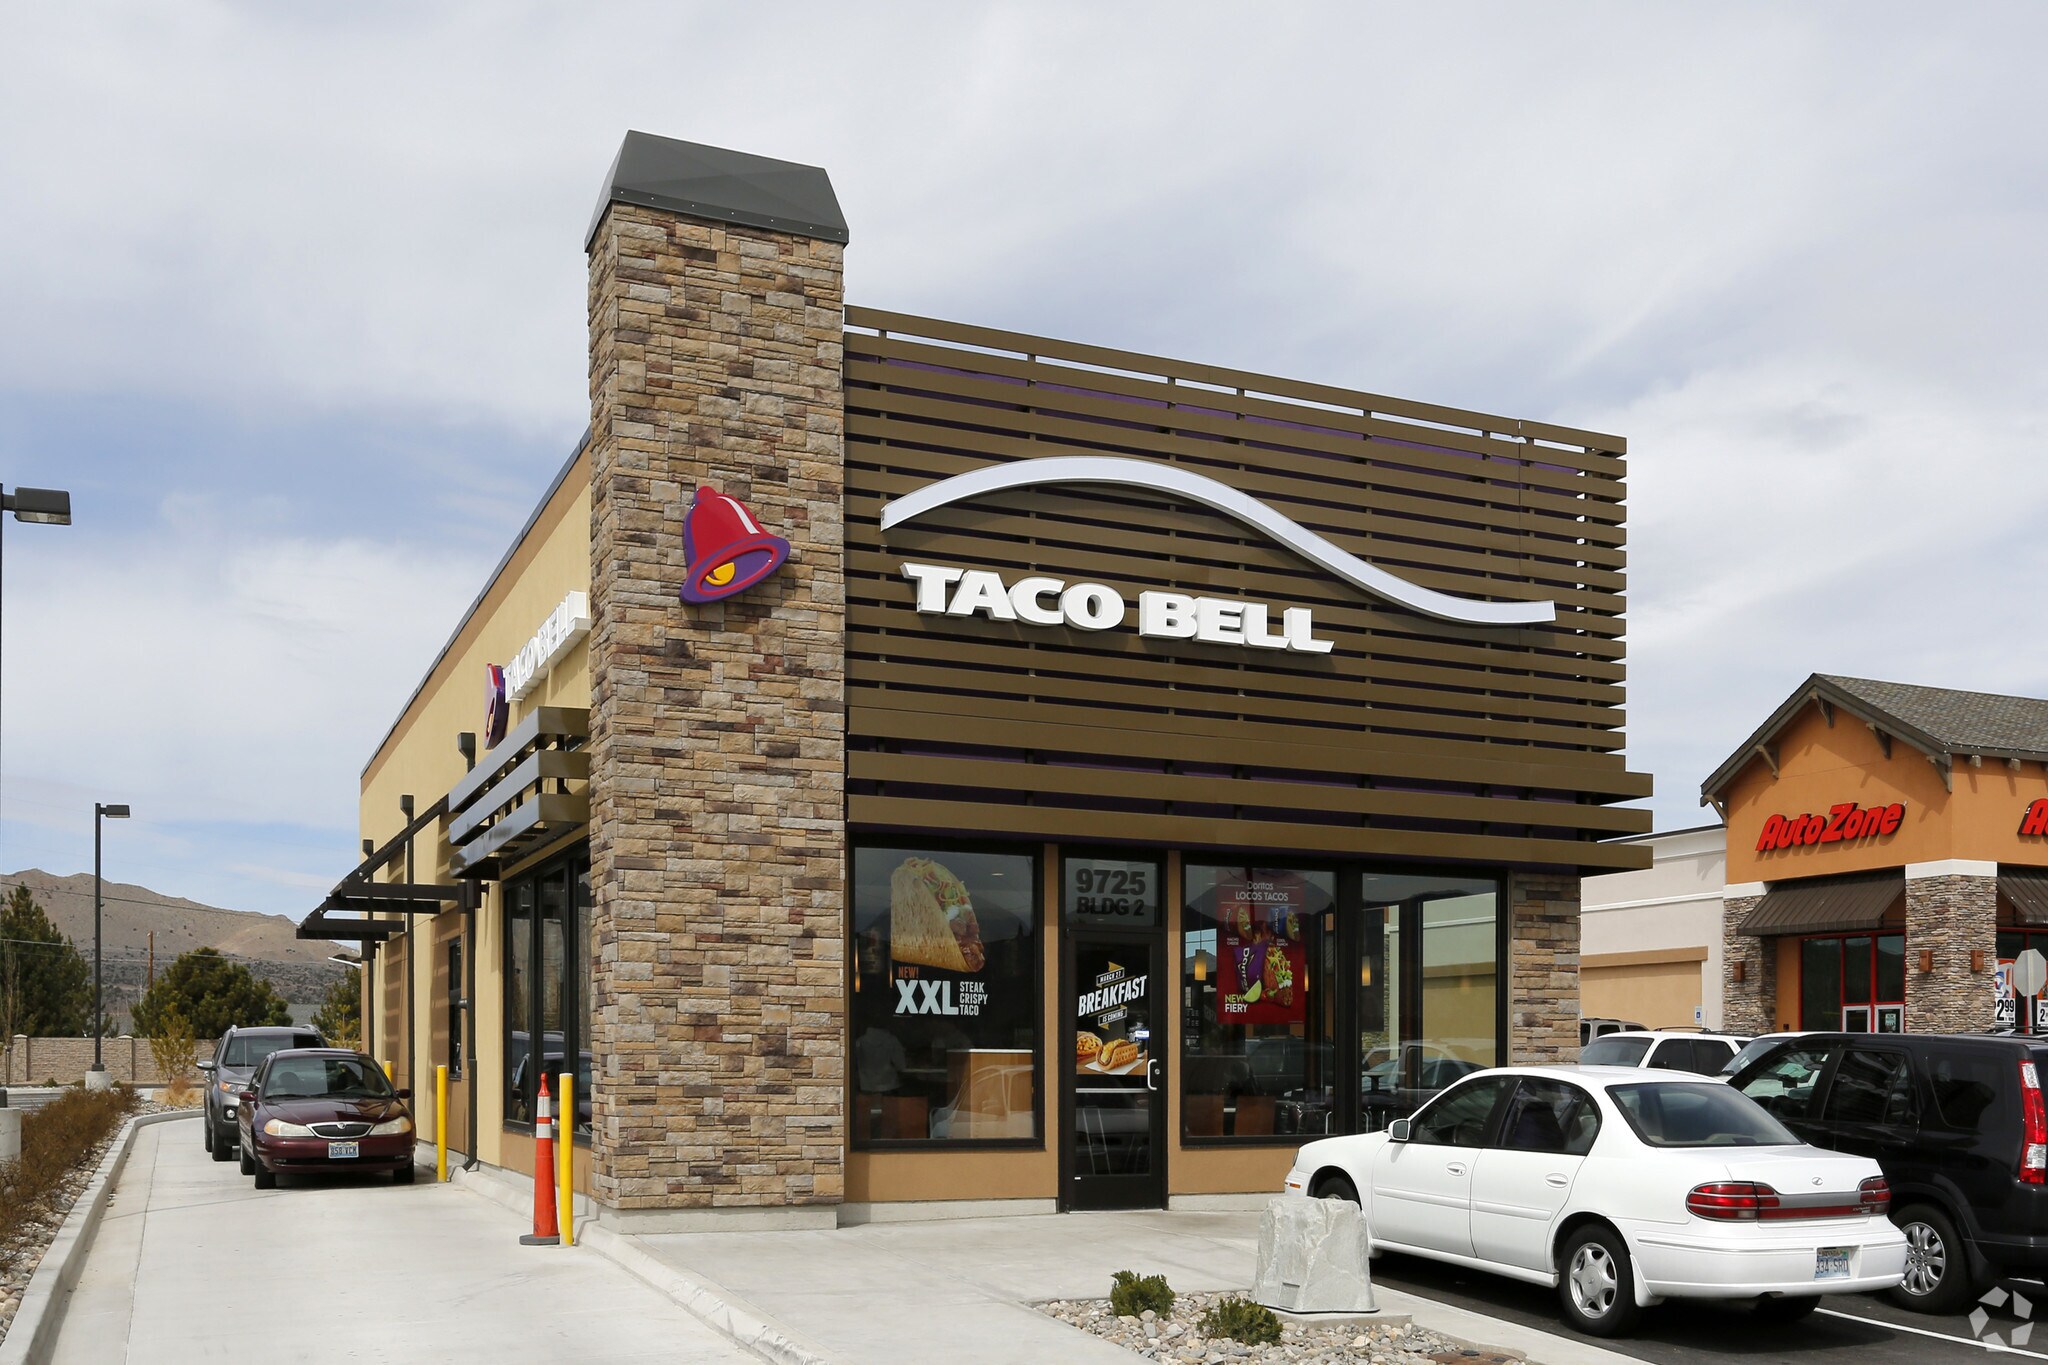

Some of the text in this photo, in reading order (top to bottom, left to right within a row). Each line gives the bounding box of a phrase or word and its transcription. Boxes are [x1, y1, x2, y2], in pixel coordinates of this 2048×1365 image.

[900, 562, 1335, 654] TACO BELL
[503, 591, 587, 703] TACO BELL
[1755, 802, 1906, 851] AutoZone
[1076, 868, 1146, 895] 9725
[1247, 881, 1274, 890] Doritos
[1235, 892, 1289, 901] LOCOS TACOS
[1077, 896, 1145, 916] BLDG 2
[898, 966, 919, 978] NEW!
[1100, 972, 1115, 983] MARCH
[960, 981, 985, 993] STEAK
[895, 979, 959, 1015] XXL
[960, 993, 988, 1005] CRISPY
[1078, 975, 1148, 1017] BREAKFAST
[1225, 994, 1244, 1003] NEW
[960, 1005, 979, 1016] TACO
[1225, 1004, 1248, 1013] FIERY
[1102, 1010, 1124, 1023] IS COMING
